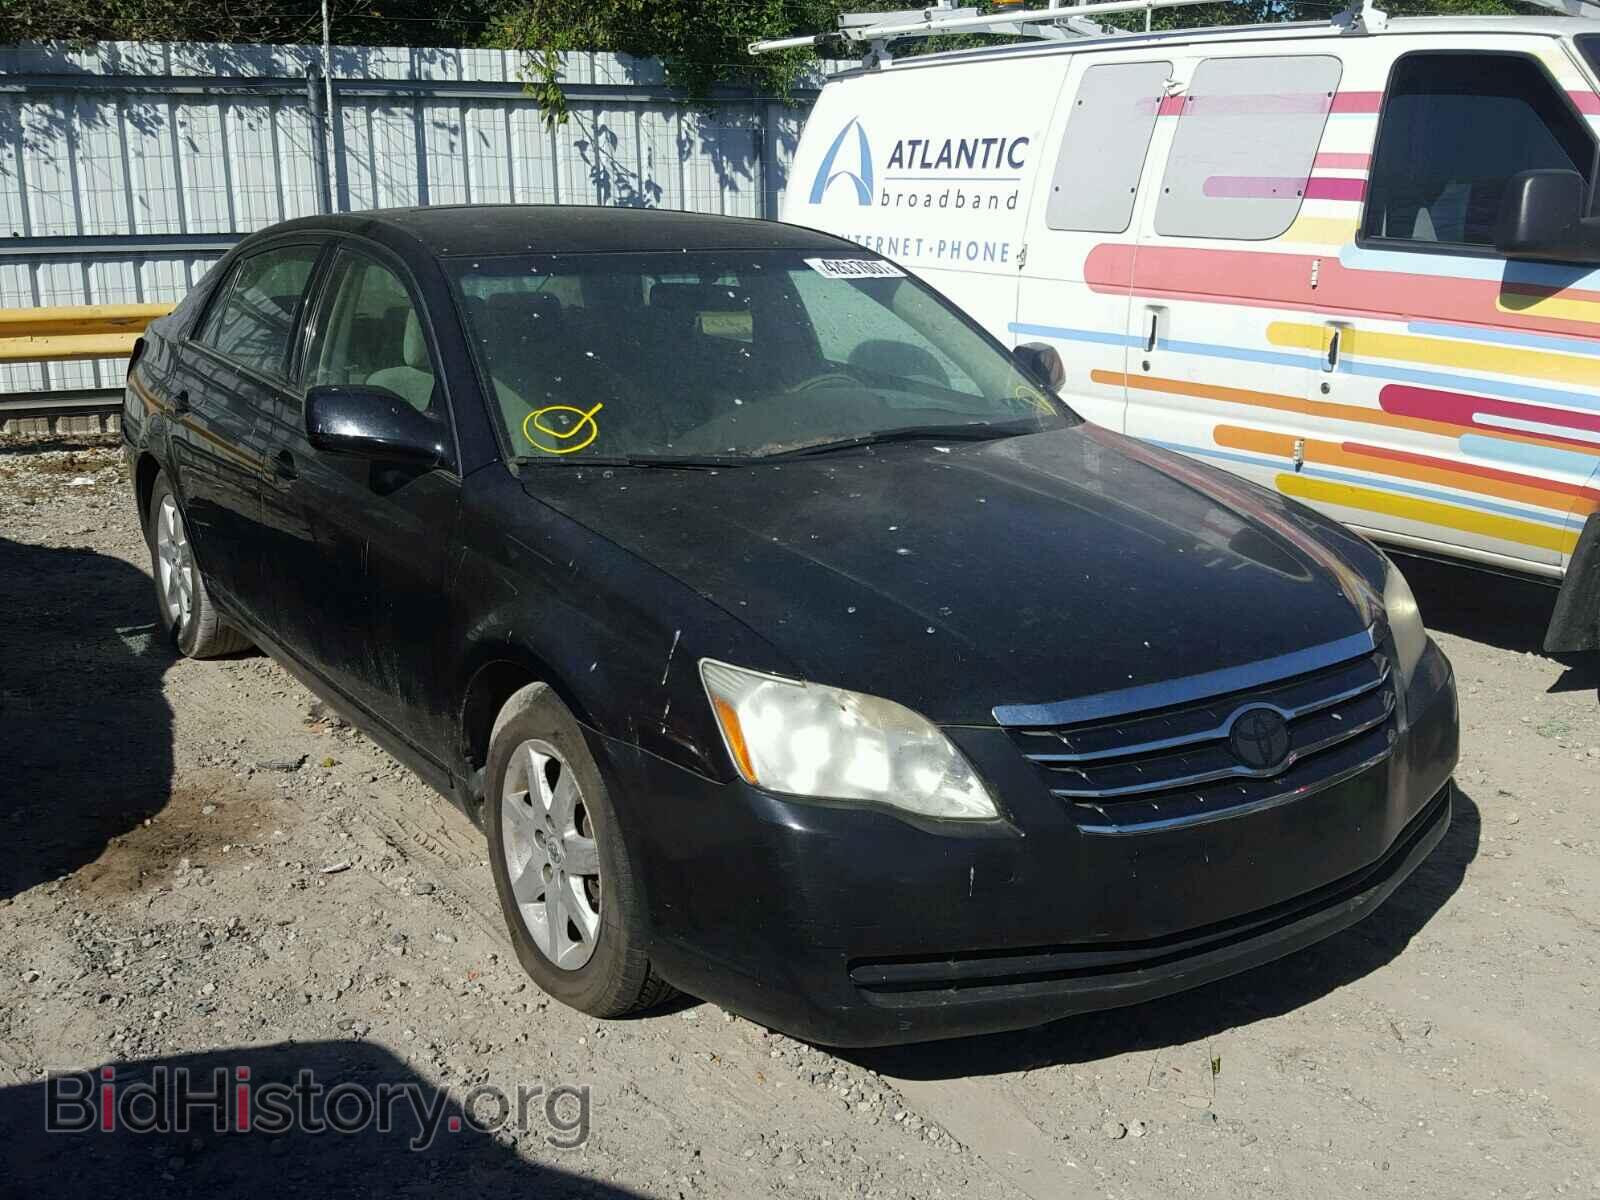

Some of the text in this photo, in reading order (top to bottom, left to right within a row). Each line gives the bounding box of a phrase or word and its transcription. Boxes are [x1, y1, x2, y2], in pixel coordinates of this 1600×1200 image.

[887, 136, 1030, 170] ATLANTIC
[881, 188, 1018, 210] broadband
[840, 234, 1009, 263] TERNET PHONE
